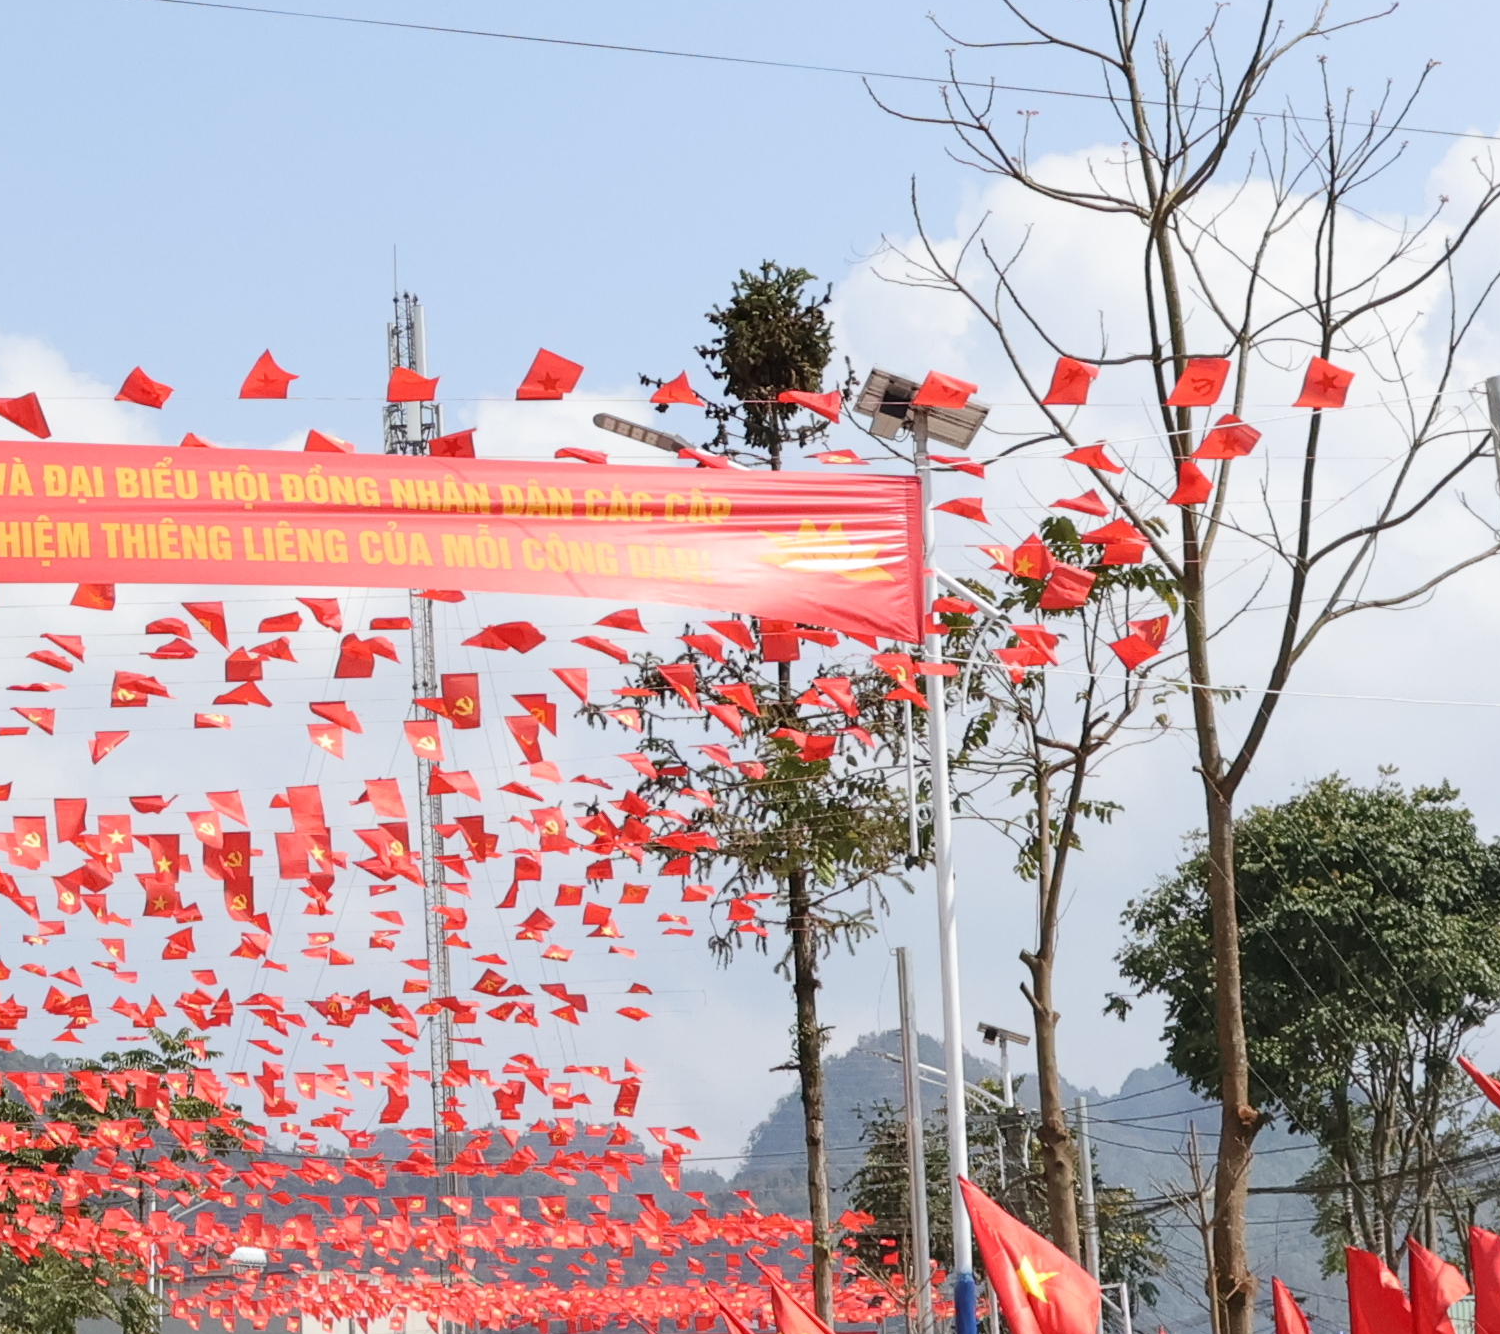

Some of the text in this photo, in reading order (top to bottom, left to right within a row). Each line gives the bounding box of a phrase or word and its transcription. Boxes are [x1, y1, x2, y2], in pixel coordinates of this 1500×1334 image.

[43, 465, 105, 504] ĐẠI
[116, 456, 199, 500] BIỂU
[211, 465, 271, 510] HỘI
[281, 464, 381, 508] ĐỒNG
[390, 473, 490, 515] NHÂN
[499, 478, 573, 520] DÂN
[585, 483, 652, 523] CÁC
[664, 484, 732, 524] CẤP
[101, 517, 233, 562] THIÊNG
[244, 521, 348, 564] LIÊNG
[359, 520, 433, 567] CỦA
[441, 523, 511, 570] MỖI
[521, 532, 618, 576] CÔNG
